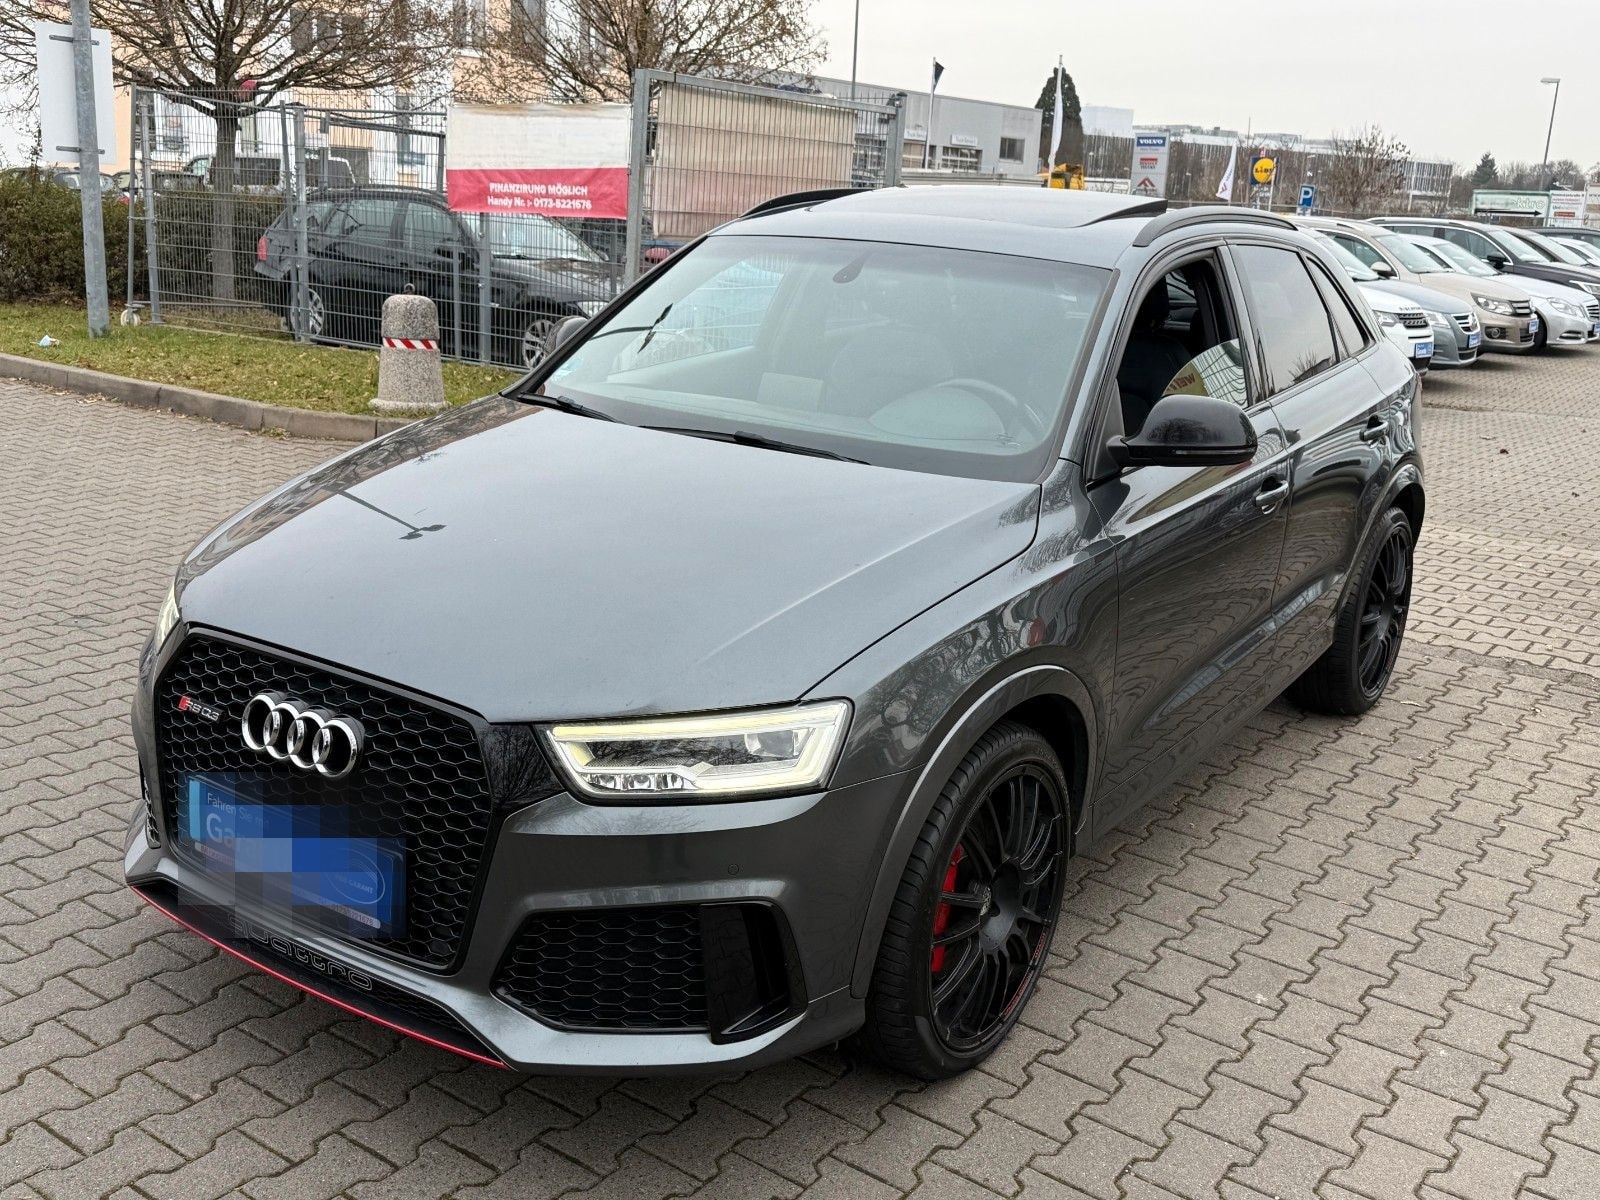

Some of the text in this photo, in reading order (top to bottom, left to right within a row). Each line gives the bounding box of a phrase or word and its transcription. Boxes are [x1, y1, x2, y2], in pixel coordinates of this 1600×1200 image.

[489, 181, 588, 195] FINANZIRUNG MÖGLICH
[1300, 187, 1313, 205] P
[487, 196, 513, 208] Handy
[207, 792, 237, 817] Fahren
[228, 913, 373, 991] quattro
